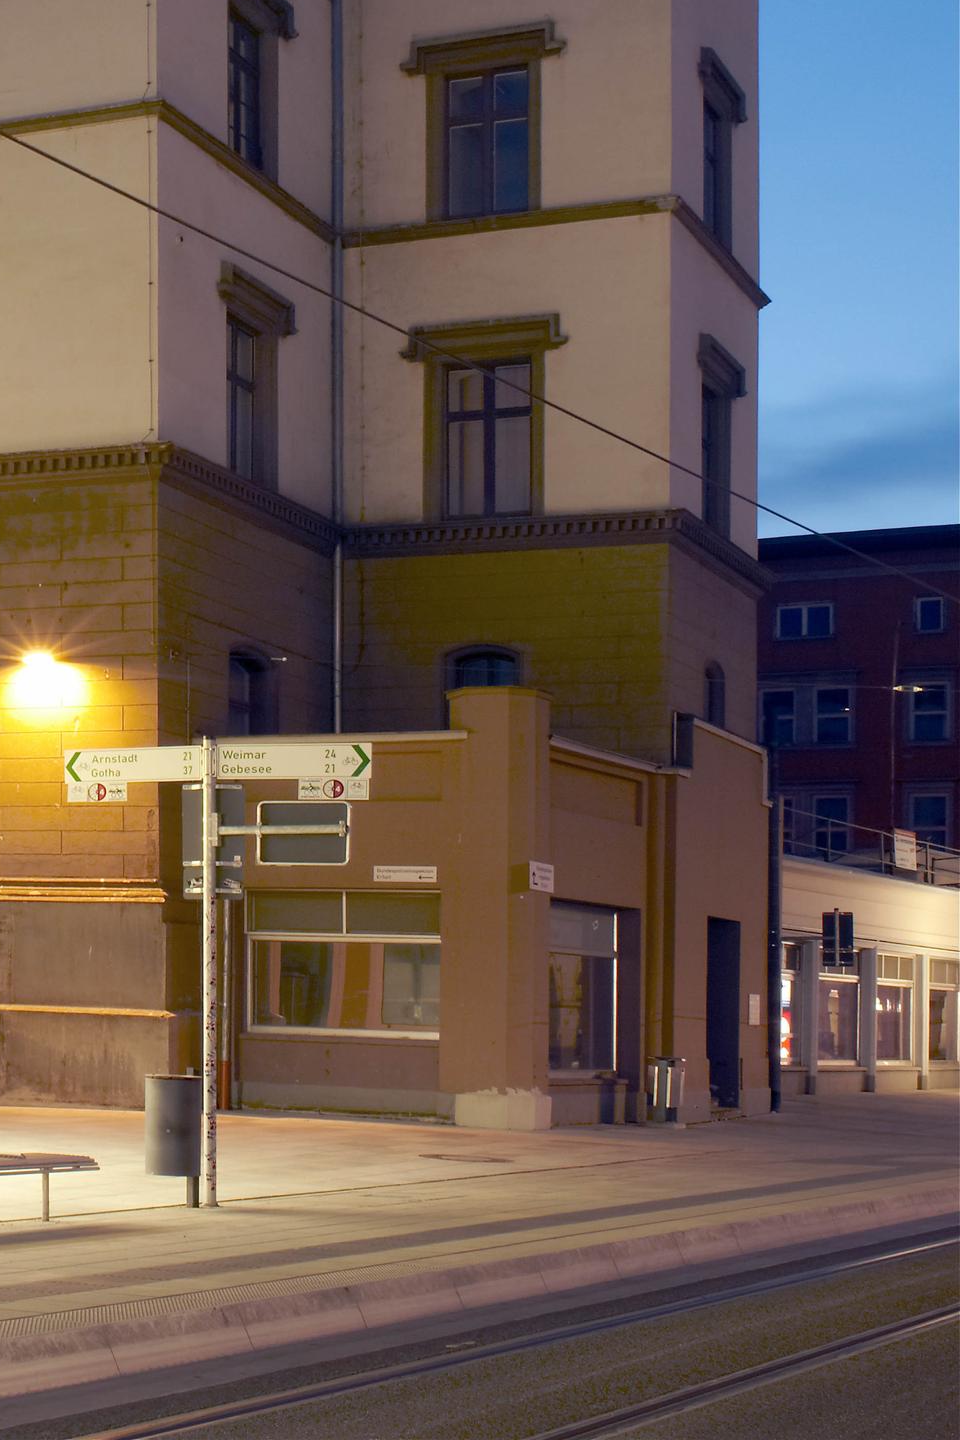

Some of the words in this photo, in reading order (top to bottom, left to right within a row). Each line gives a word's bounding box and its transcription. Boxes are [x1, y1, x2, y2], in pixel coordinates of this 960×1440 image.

[91, 753, 139, 764] Arnstadt
[183, 751, 193, 761] 21
[222, 749, 267, 760] Weimar
[324, 749, 337, 759] 24
[91, 767, 121, 778] Gotha
[183, 765, 193, 776] 37
[221, 764, 273, 774] Gebesee
[324, 763, 336, 774] 21
